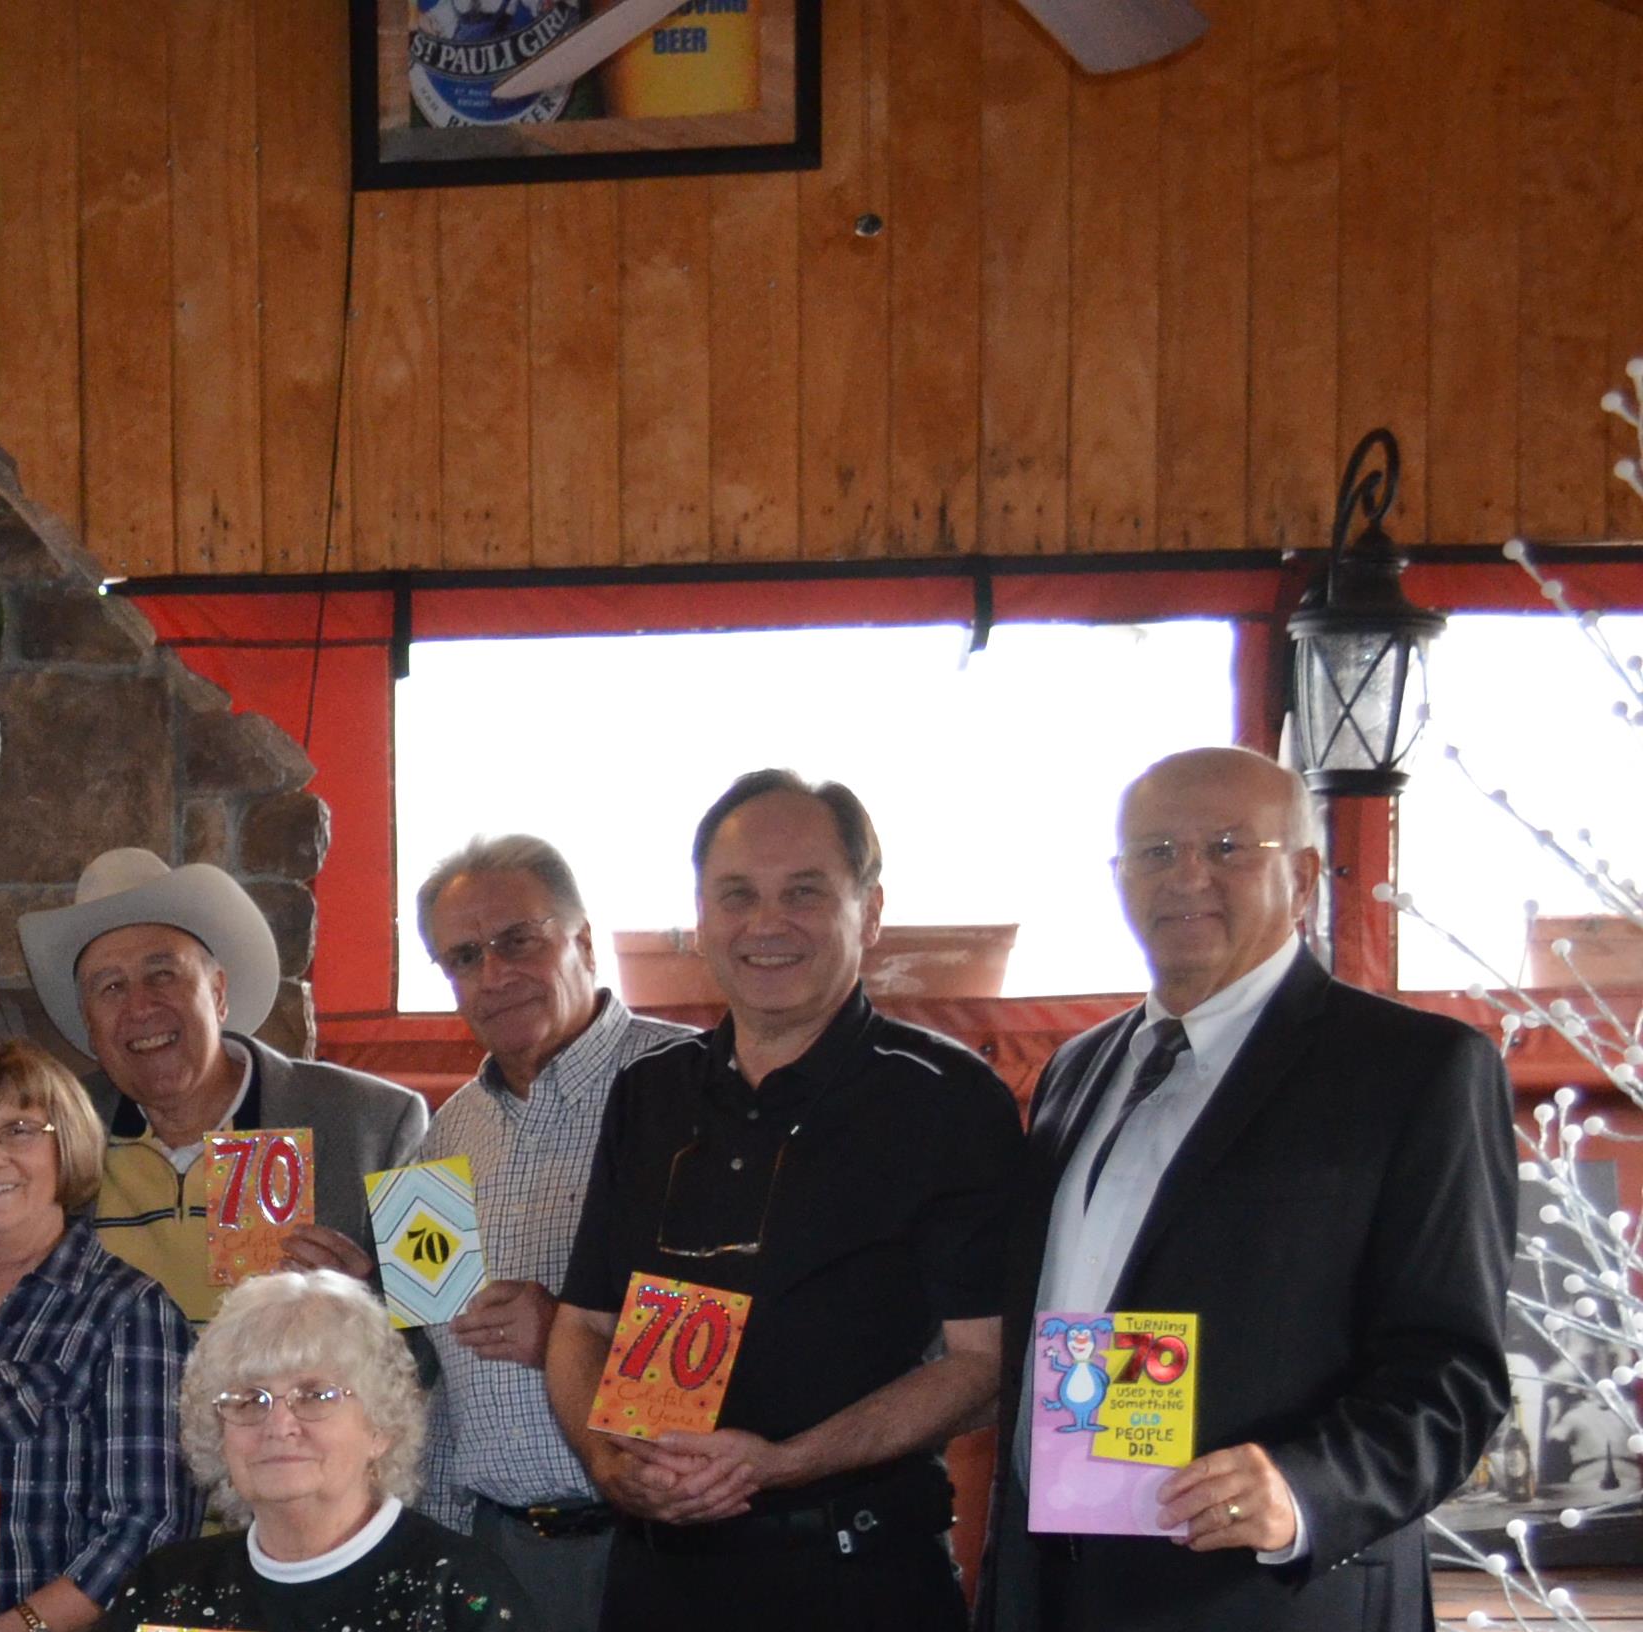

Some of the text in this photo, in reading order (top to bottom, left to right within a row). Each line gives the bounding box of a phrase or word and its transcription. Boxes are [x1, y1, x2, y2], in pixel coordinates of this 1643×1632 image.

[436, 40, 517, 75] PAULI
[517, 6, 573, 59] GIRL
[652, 27, 708, 54] BEER
[212, 1136, 304, 1230] 70
[406, 1228, 450, 1265] 70
[618, 1285, 732, 1391] 70
[1113, 1331, 1189, 1385] 70
[618, 1382, 688, 1408] Colorful
[1115, 1426, 1175, 1441] PEOPLE
[1130, 1412, 1161, 1426] OLD
